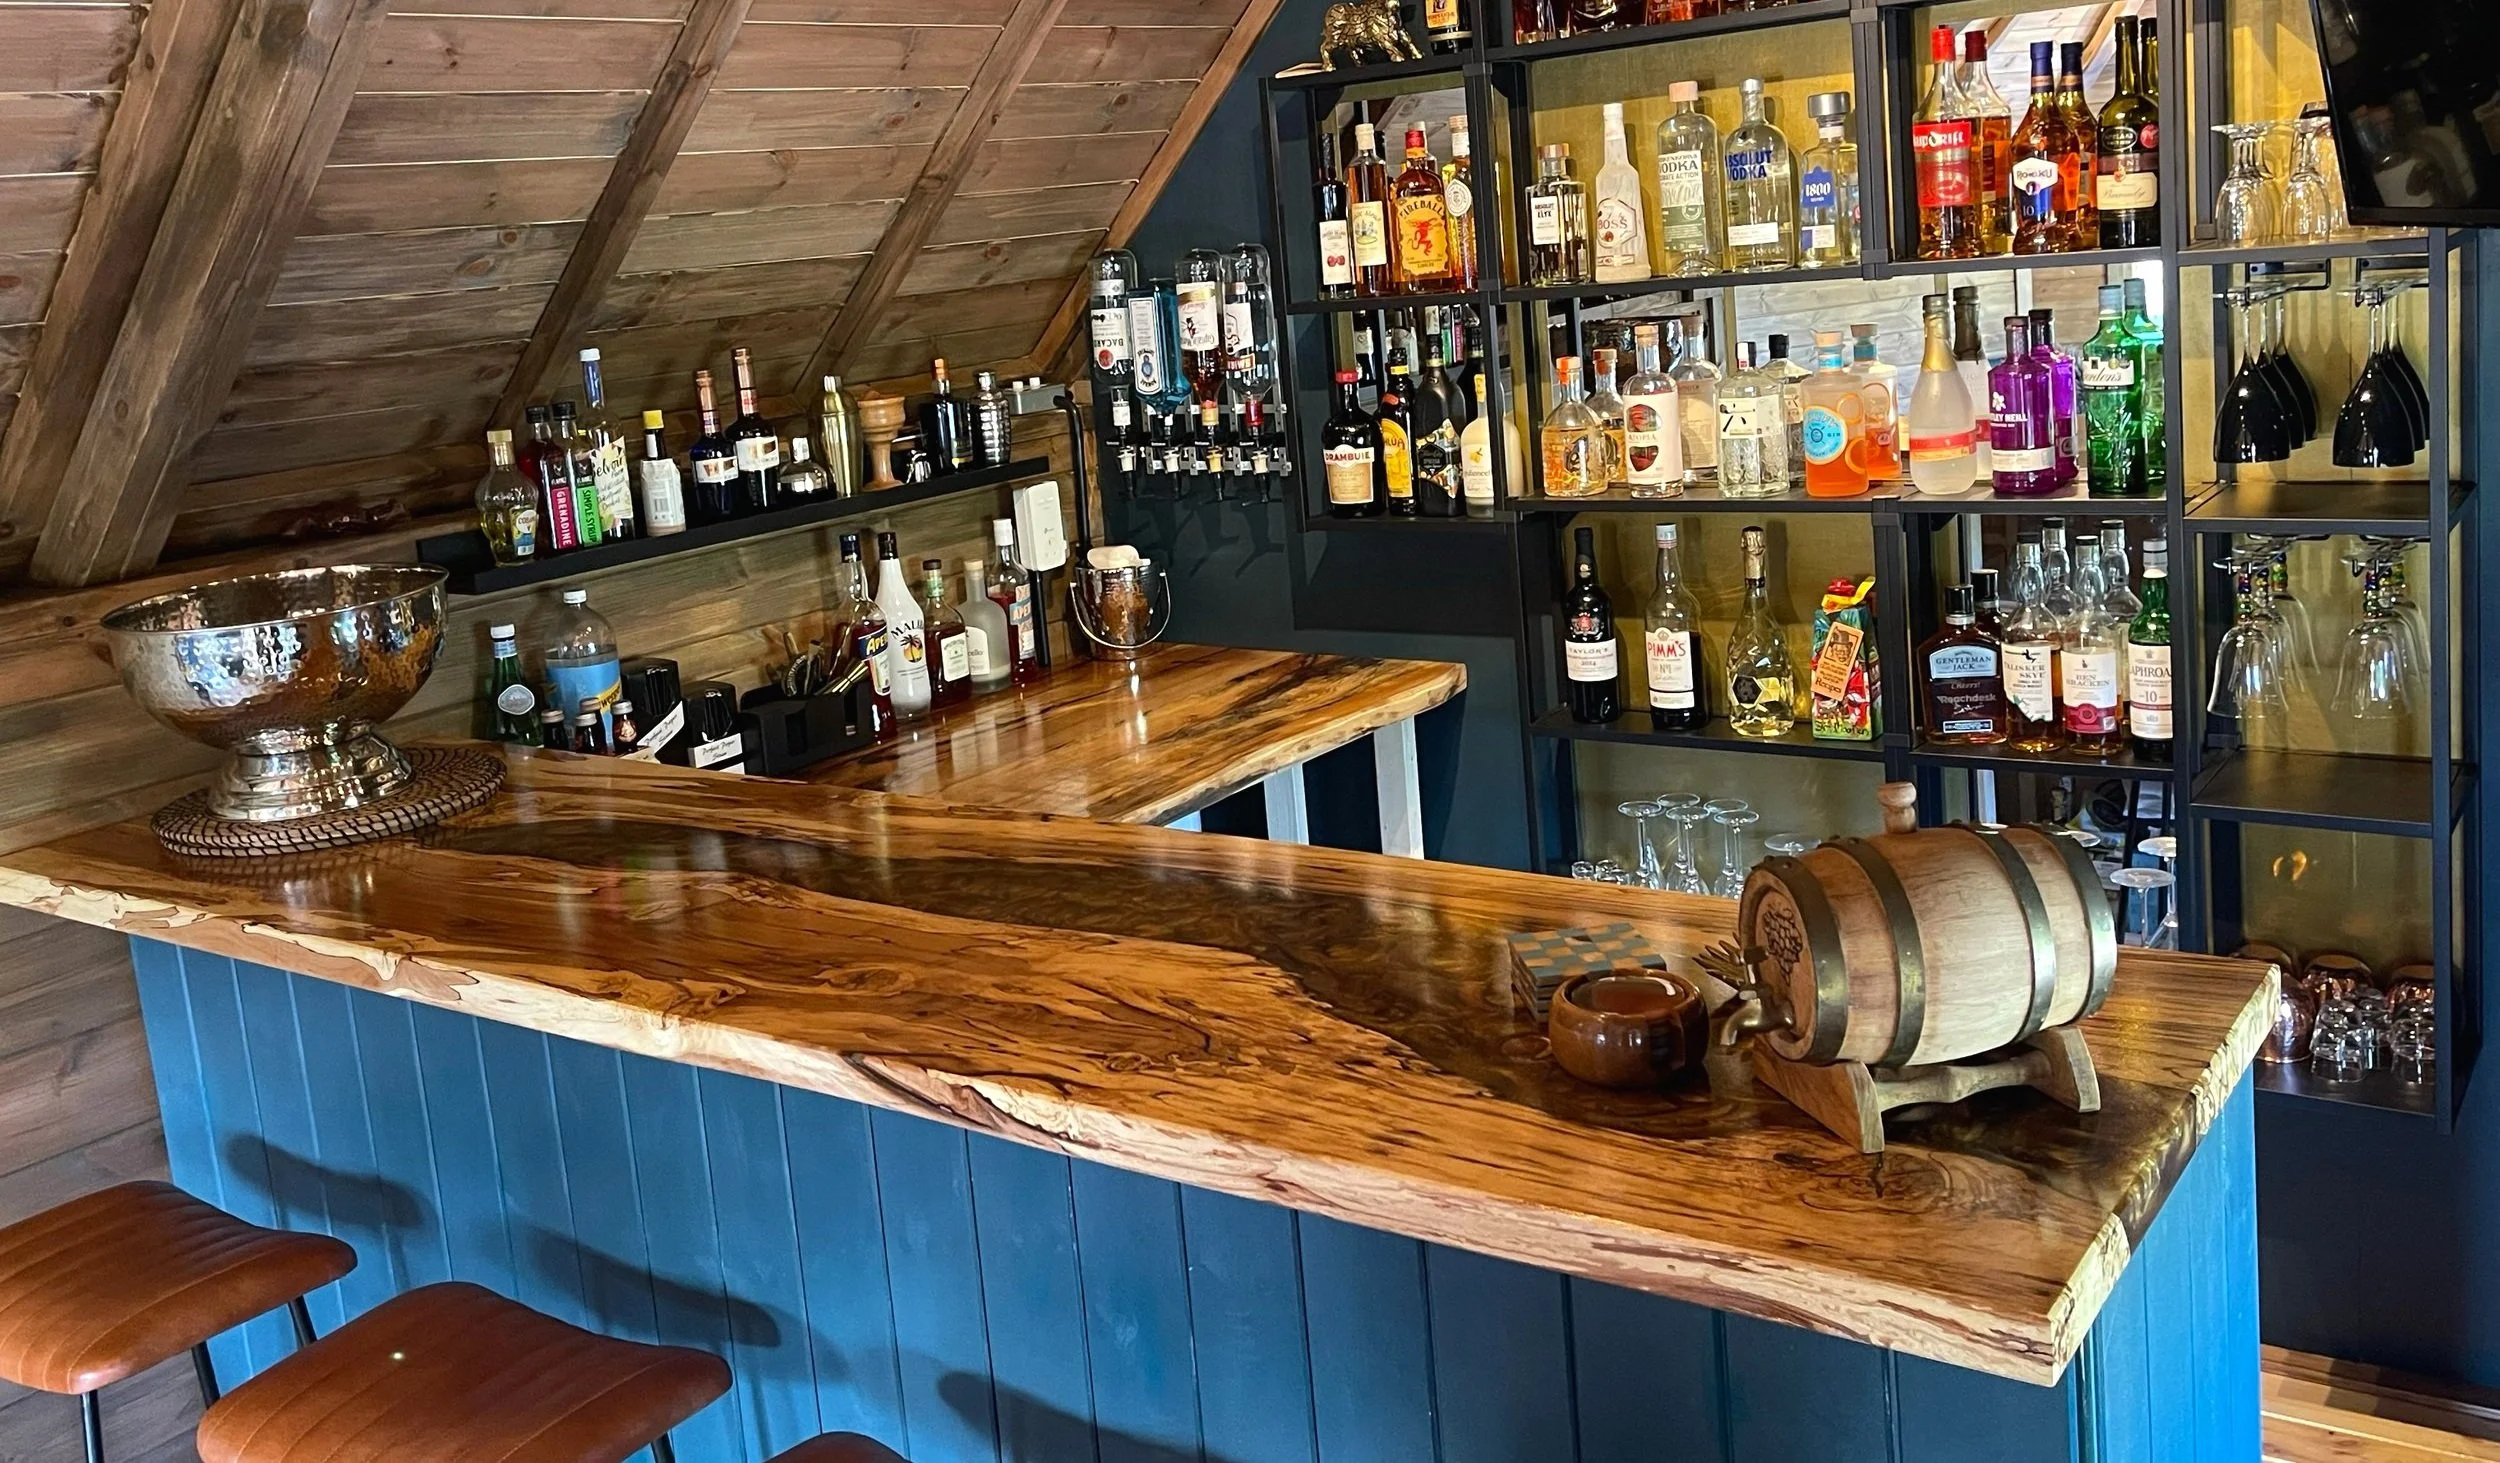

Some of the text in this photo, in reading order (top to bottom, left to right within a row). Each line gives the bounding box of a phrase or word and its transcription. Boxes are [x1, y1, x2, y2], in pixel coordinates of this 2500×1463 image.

[1806, 182, 1831, 197] 1800
[1400, 200, 1446, 218] FIREBALL
[2023, 205, 2035, 216] 10
[2085, 366, 2122, 382] ordon's
[1325, 451, 1371, 462] DRAMBUIE
[556, 491, 573, 546] GRENADINE
[583, 489, 598, 543] SIMPLE SYRUP
[1648, 641, 1687, 658] PIMM'S
[1936, 656, 1992, 665] GENTLEMAN
[1953, 663, 1976, 671] JACK
[2019, 671, 2046, 680] SKYE
[2130, 665, 2171, 678] APHROA
[2145, 691, 2158, 703] 10
